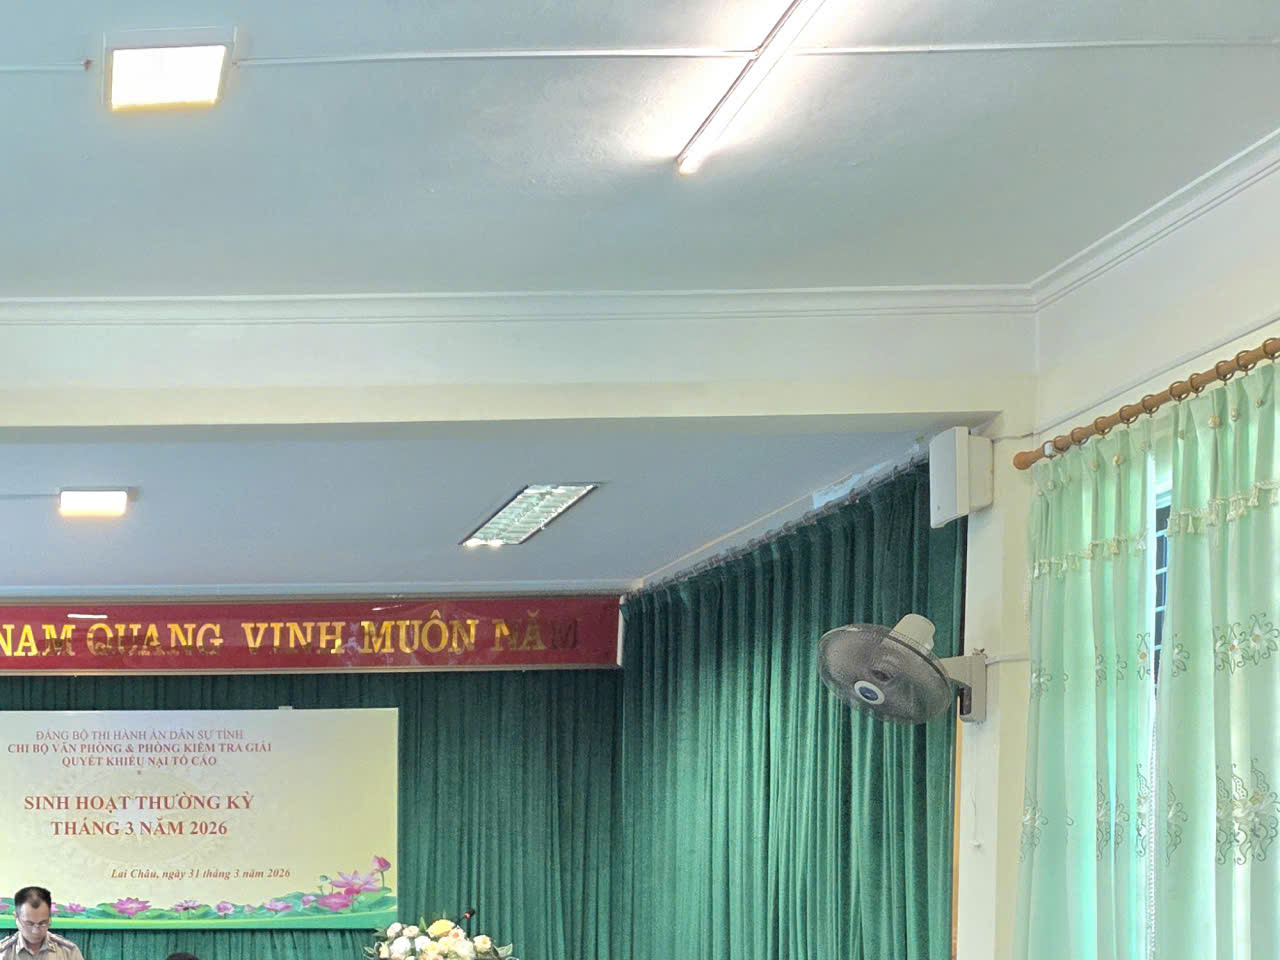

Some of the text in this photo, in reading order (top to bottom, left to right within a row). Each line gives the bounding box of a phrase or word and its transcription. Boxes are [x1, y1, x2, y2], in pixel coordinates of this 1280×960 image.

[87, 622, 224, 657] QUANG
[241, 620, 347, 656] VINH
[360, 609, 480, 655] MUÔN
[492, 608, 580, 653] NĂM
[91, 730, 111, 741] THI
[113, 728, 147, 741] HÀNH
[7, 742, 30, 754] CHI
[33, 741, 50, 756] BỘ
[52, 740, 77, 754] VĂN
[80, 741, 122, 754] PHÒNG
[125, 742, 134, 754] &
[138, 741, 181, 754] PHÒNG
[220, 743, 243, 753] TRA
[148, 755, 169, 770] NẠI
[191, 754, 217, 767] CÁO
[24, 794, 70, 811] SINH
[75, 794, 131, 815] HOẠT
[135, 791, 221, 811] THƯỜNG
[51, 816, 229, 837] THÁNG 3 NĂM 2026
[111, 868, 128, 879] Lai
[130, 868, 160, 881] Châu,
[162, 868, 186, 882] ngày
[202, 868, 231, 881] tháng
[233, 868, 240, 879] 3
[242, 868, 265, 879] năm
[267, 867, 291, 879] 2026
